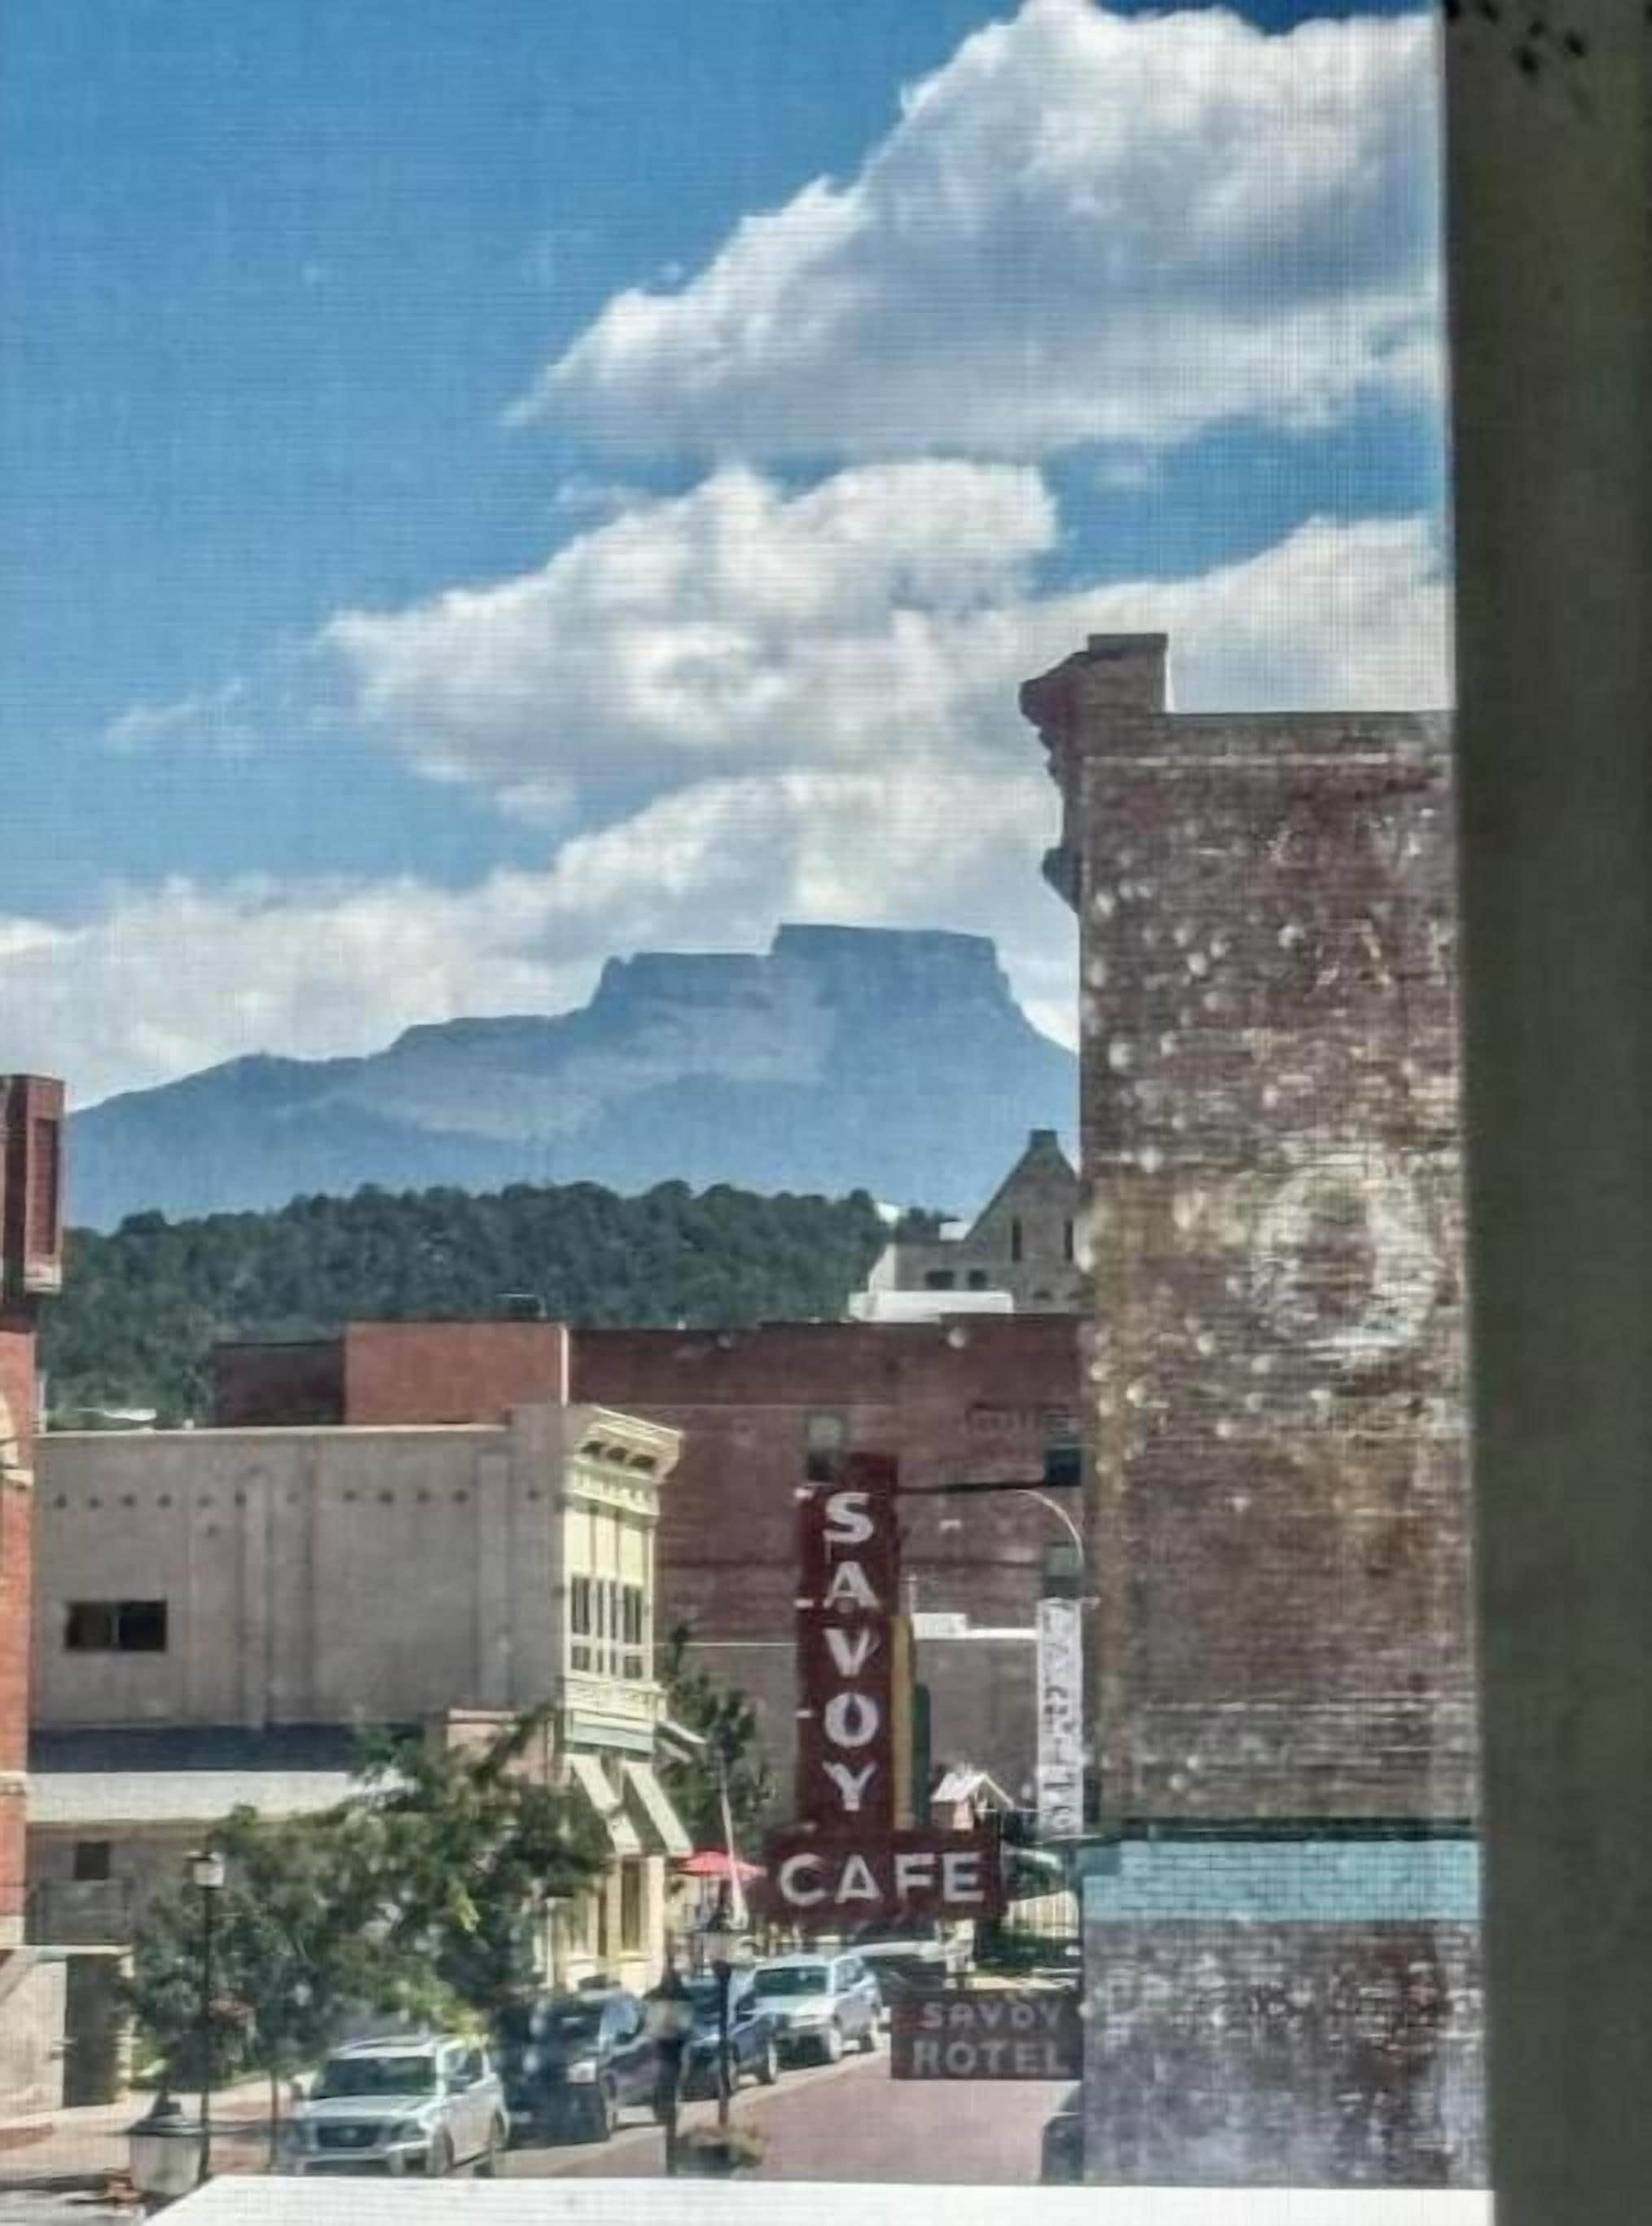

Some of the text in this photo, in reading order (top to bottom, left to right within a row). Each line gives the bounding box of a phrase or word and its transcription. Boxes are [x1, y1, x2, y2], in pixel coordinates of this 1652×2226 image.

[823, 1492, 881, 1811] SAVOY
[780, 1853, 985, 1906] CAFE
[920, 2001, 1062, 2029] SAVOY
[912, 2039, 1070, 2075] HOTEL
